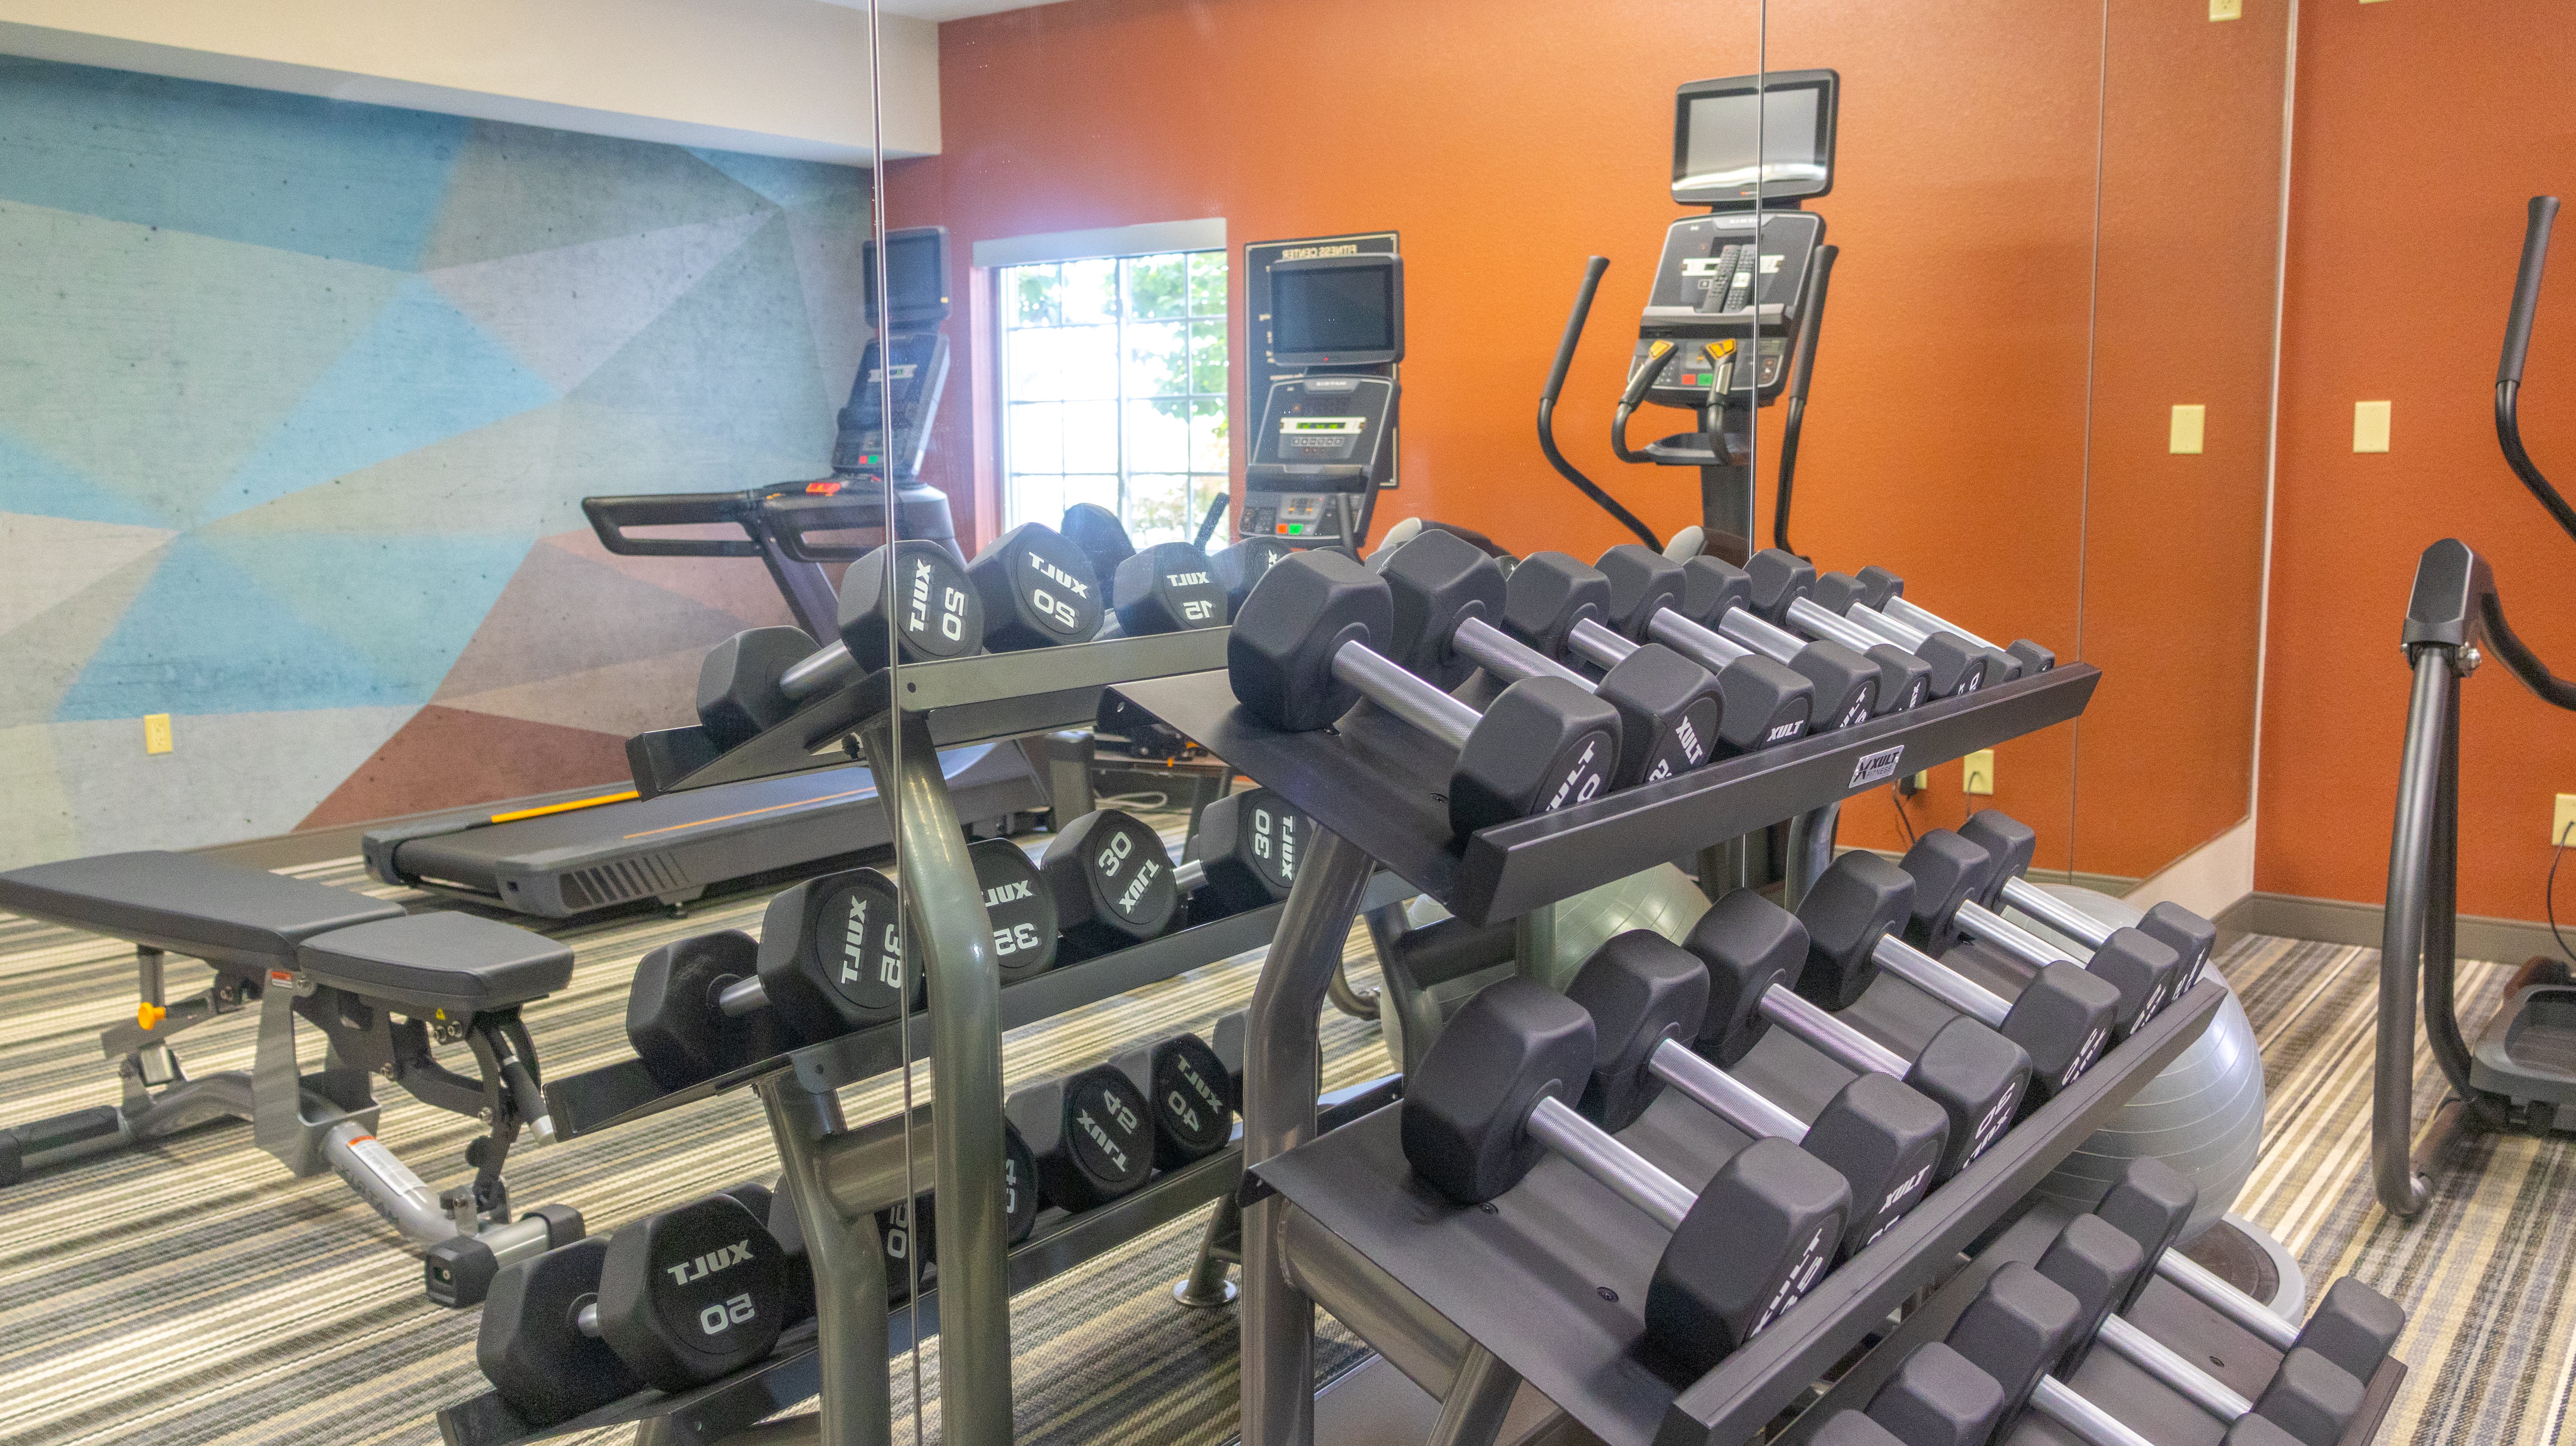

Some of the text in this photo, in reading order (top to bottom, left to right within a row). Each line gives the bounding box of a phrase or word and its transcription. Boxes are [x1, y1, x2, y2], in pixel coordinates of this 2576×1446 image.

[1766, 720, 1804, 742] XULT
[1839, 687, 1866, 728] ULT
[1675, 715, 1704, 765] XULT
[1870, 751, 1900, 770] XULT
[1546, 741, 1595, 811] ULT
[1866, 765, 1893, 778] FITNESS
[1975, 1082, 2016, 1139] 30
[1878, 1164, 1931, 1215] XULT
[1749, 1228, 1822, 1339] XULT
